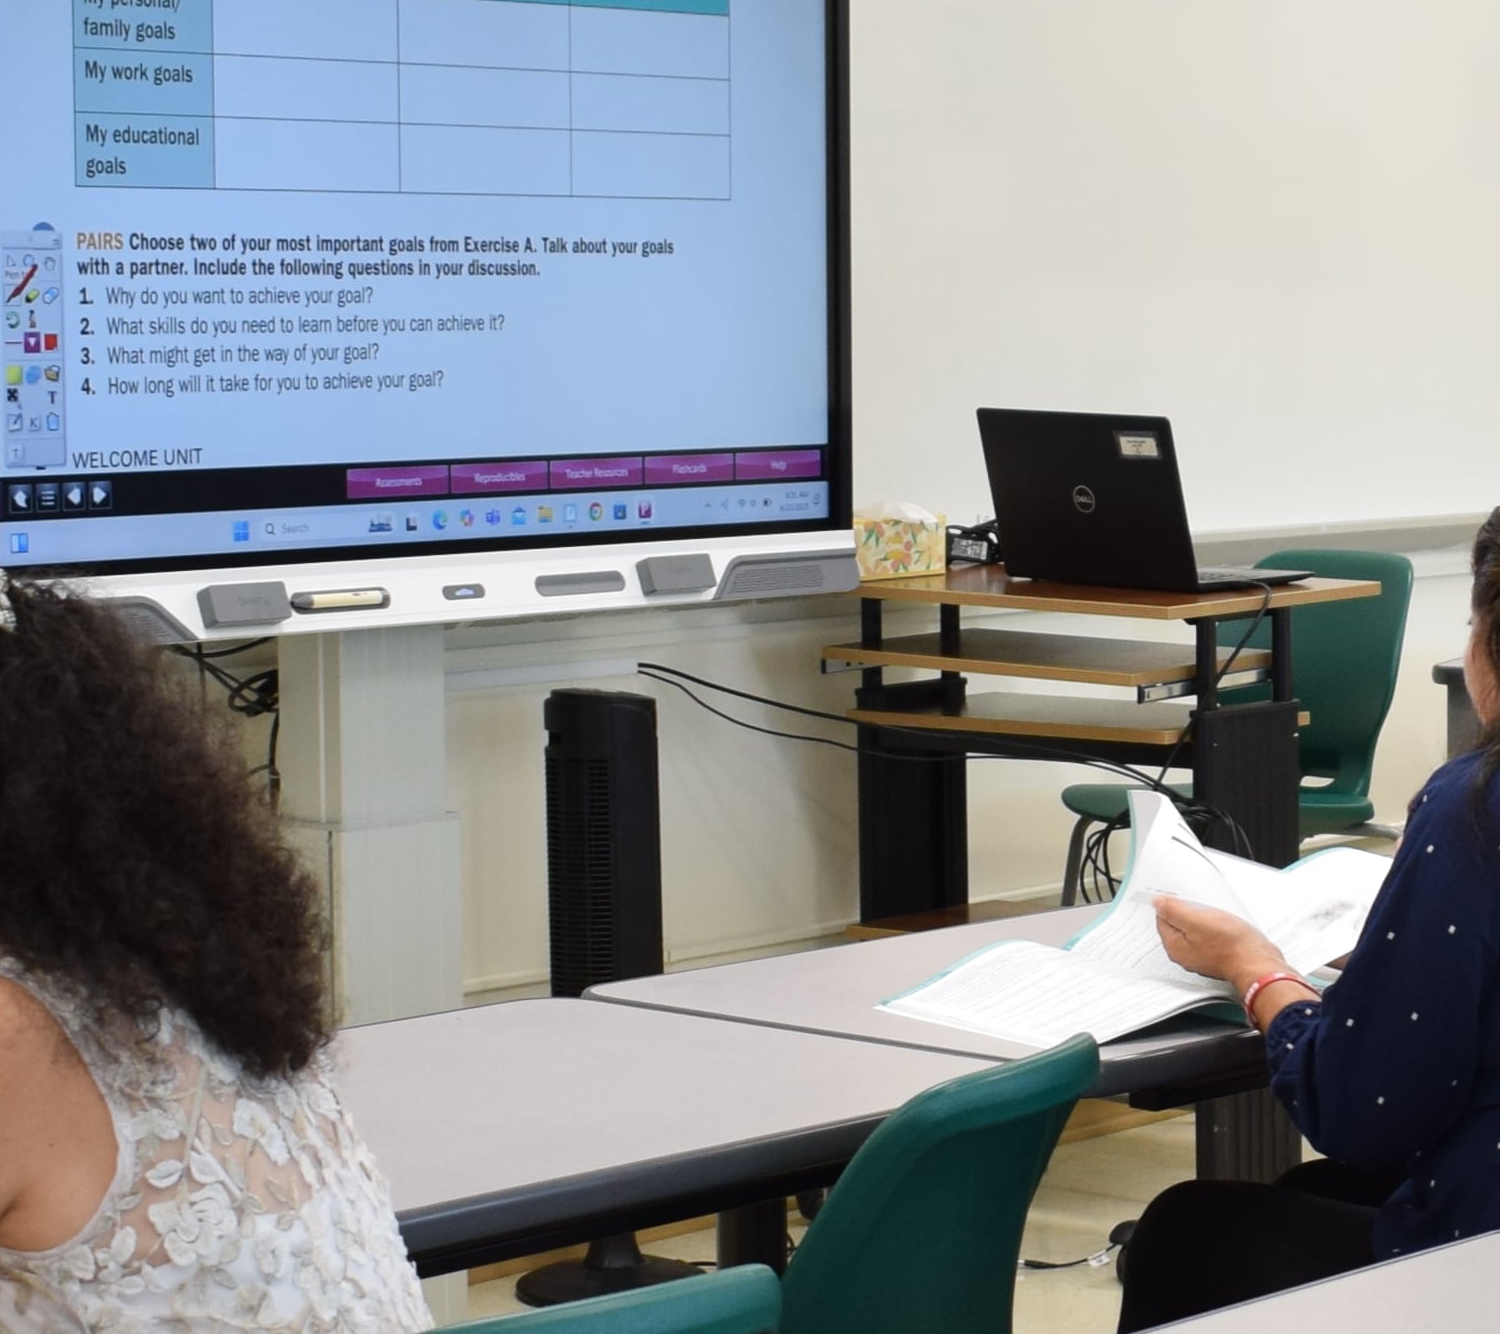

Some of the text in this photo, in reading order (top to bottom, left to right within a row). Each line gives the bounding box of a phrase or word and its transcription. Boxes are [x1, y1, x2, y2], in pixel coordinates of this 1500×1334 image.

[84, 18, 176, 43] family goals
[85, 60, 193, 86] My work goals
[86, 124, 200, 147] My educational
[86, 156, 127, 178] goals
[77, 233, 674, 257] PAIRS Choose two of your most important goals from Exercise A. Talk about your goals
[77, 258, 540, 279] with a partner. Include the following questions in your discussion.
[79, 286, 373, 308] 1. Why do you want to achieve your goal?
[80, 314, 505, 338] 2. What skills do you need to learn before you can achieve it?
[80, 344, 379, 367] 3. What might get in the way of your goal?
[81, 370, 444, 397] 4. How long will it take for you to achieve your goal?
[73, 448, 202, 469] WELCOME UNIT
